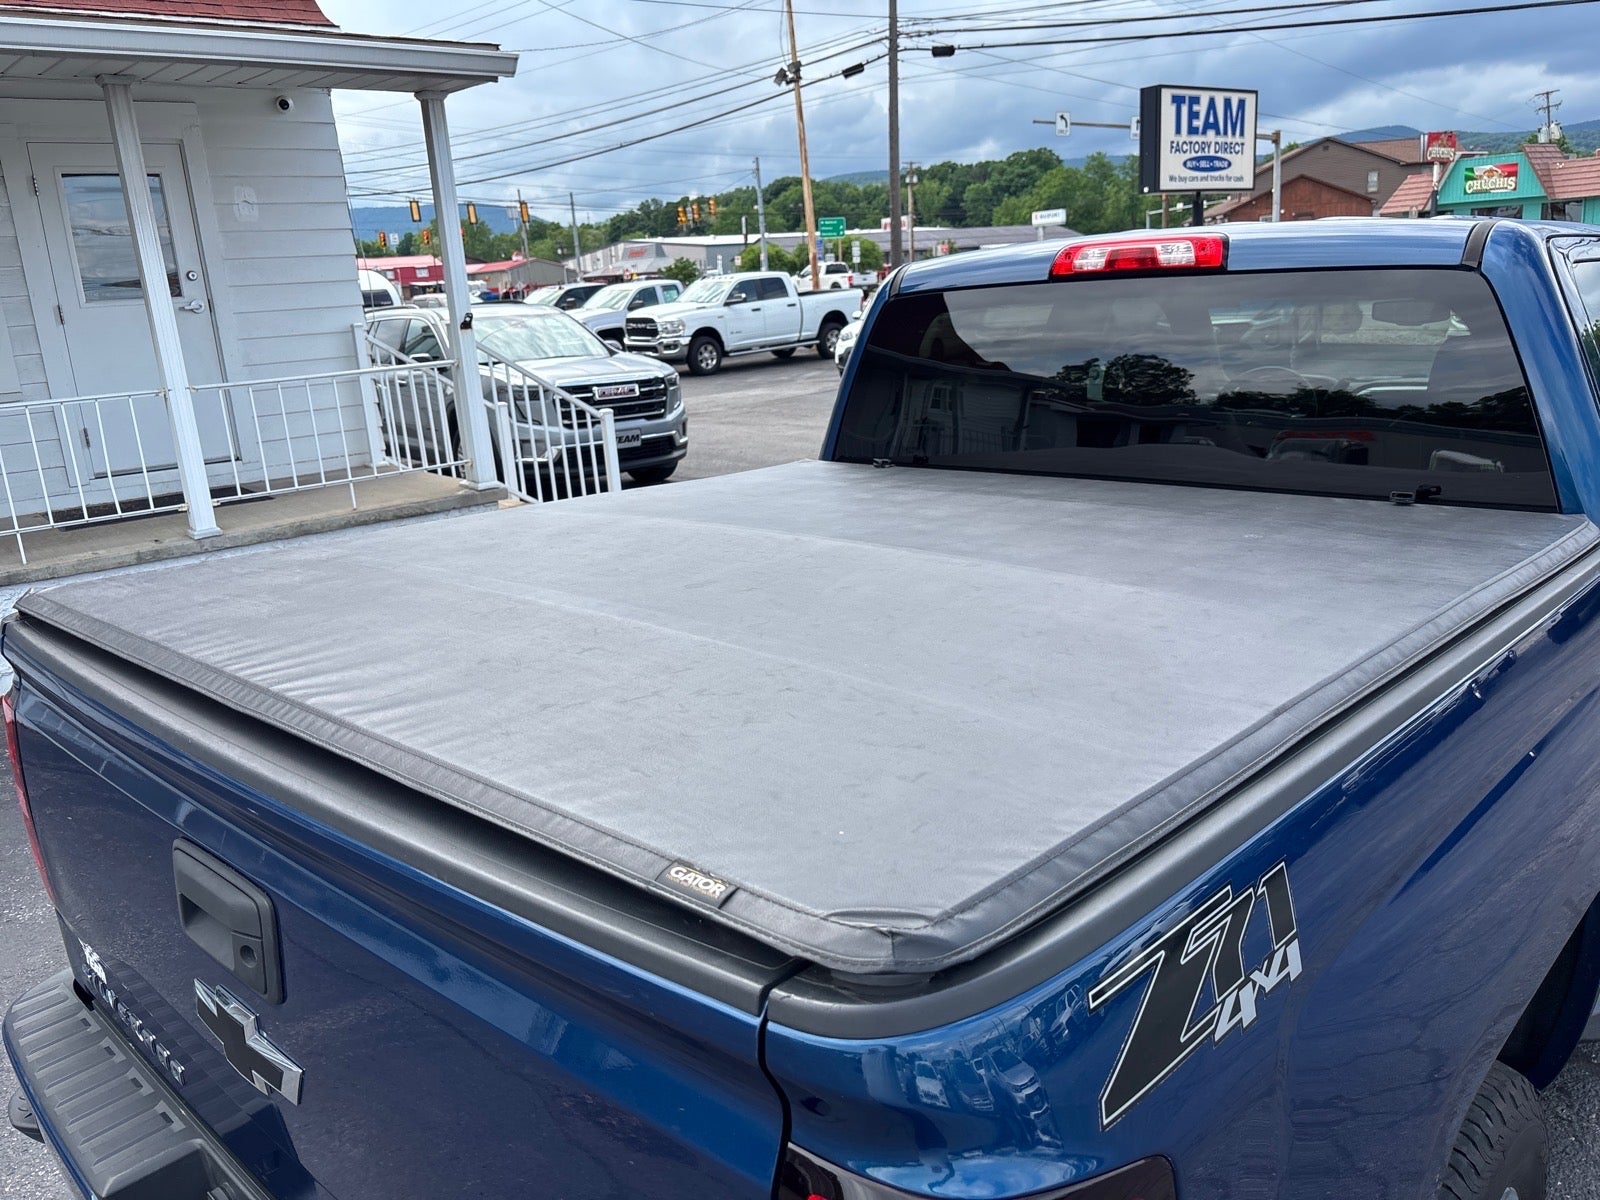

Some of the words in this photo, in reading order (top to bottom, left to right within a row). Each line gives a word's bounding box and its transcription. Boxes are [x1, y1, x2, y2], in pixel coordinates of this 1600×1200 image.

[1171, 94, 1246, 137] TEAM
[1169, 140, 1212, 155] FACTORY
[1213, 141, 1245, 155] DIRECT
[1178, 174, 1187, 184] buy
[1199, 174, 1209, 182] and
[1465, 176, 1517, 194] CHUCHIS
[616, 434, 640, 444] EAM
[669, 866, 727, 898] GATOR
[1088, 860, 1298, 1127] Z71
